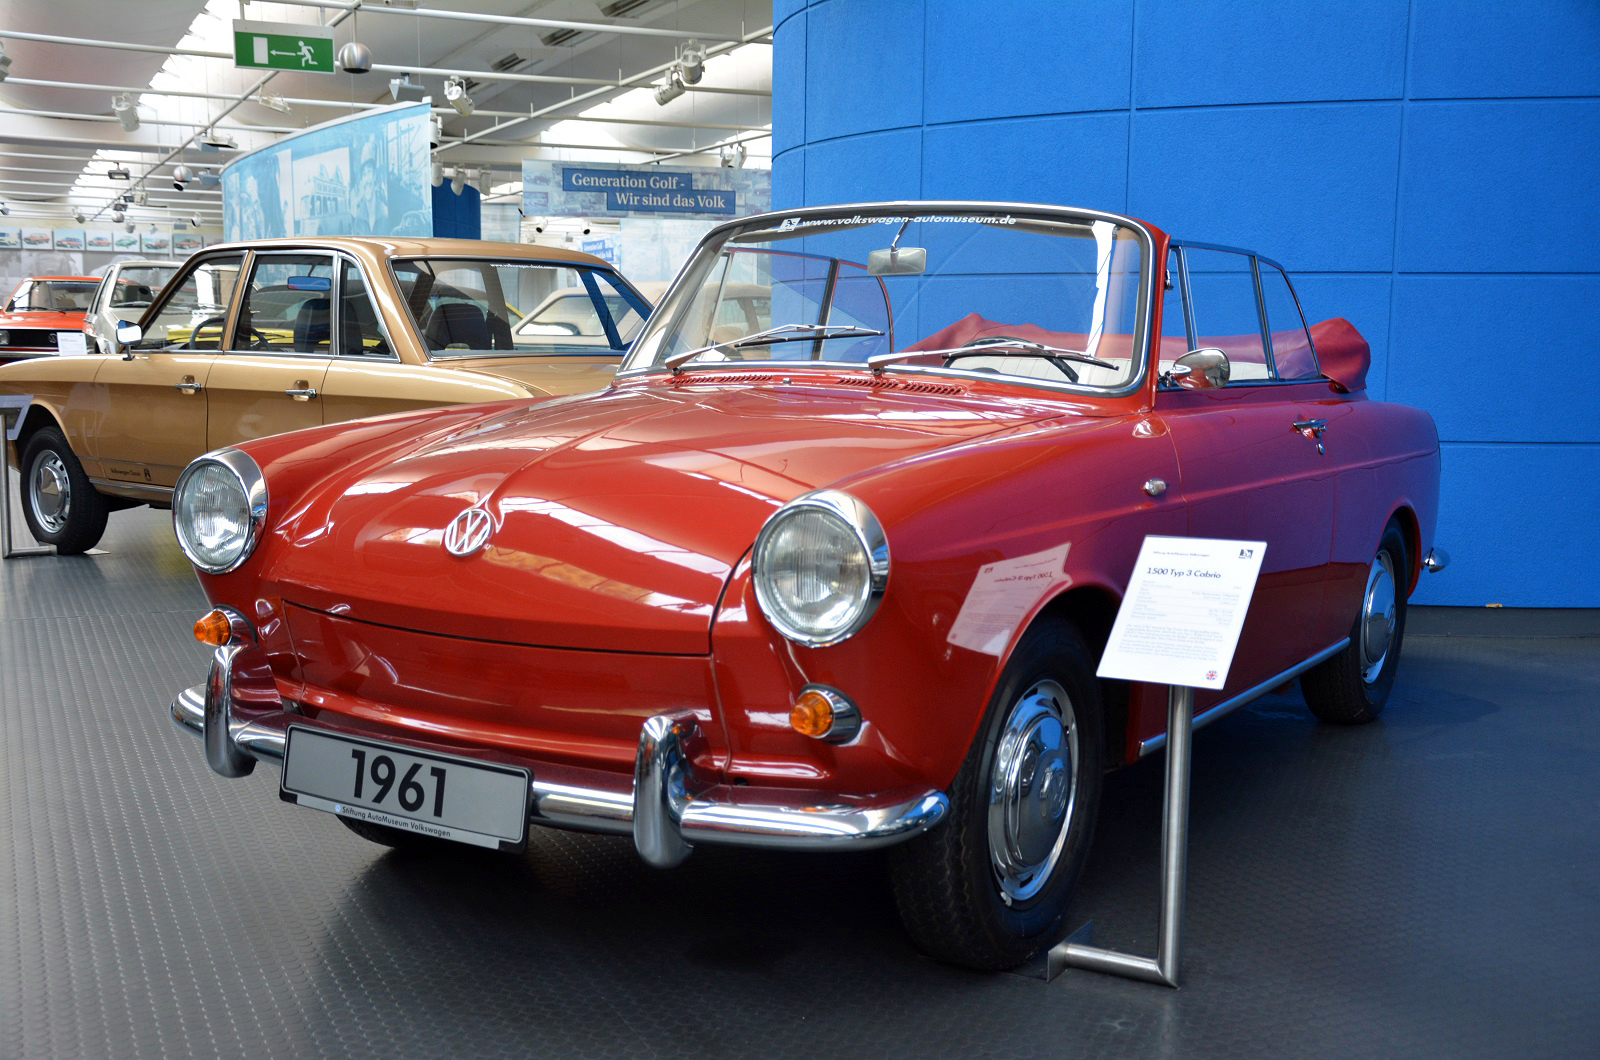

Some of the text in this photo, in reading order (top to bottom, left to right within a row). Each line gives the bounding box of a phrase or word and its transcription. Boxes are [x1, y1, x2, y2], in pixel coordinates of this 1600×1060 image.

[571, 173, 647, 188] Generation
[650, 176, 679, 189] Golf
[616, 193, 726, 208] Wir sind das Volk
[802, 214, 1017, 226] www.volkswagen-automuseum.de
[1147, 567, 1222, 579] 1500 Typ 3 Cabrio
[351, 748, 447, 818] 1961
[342, 805, 451, 837] Stiftung AutoMuseum Volkswagen
